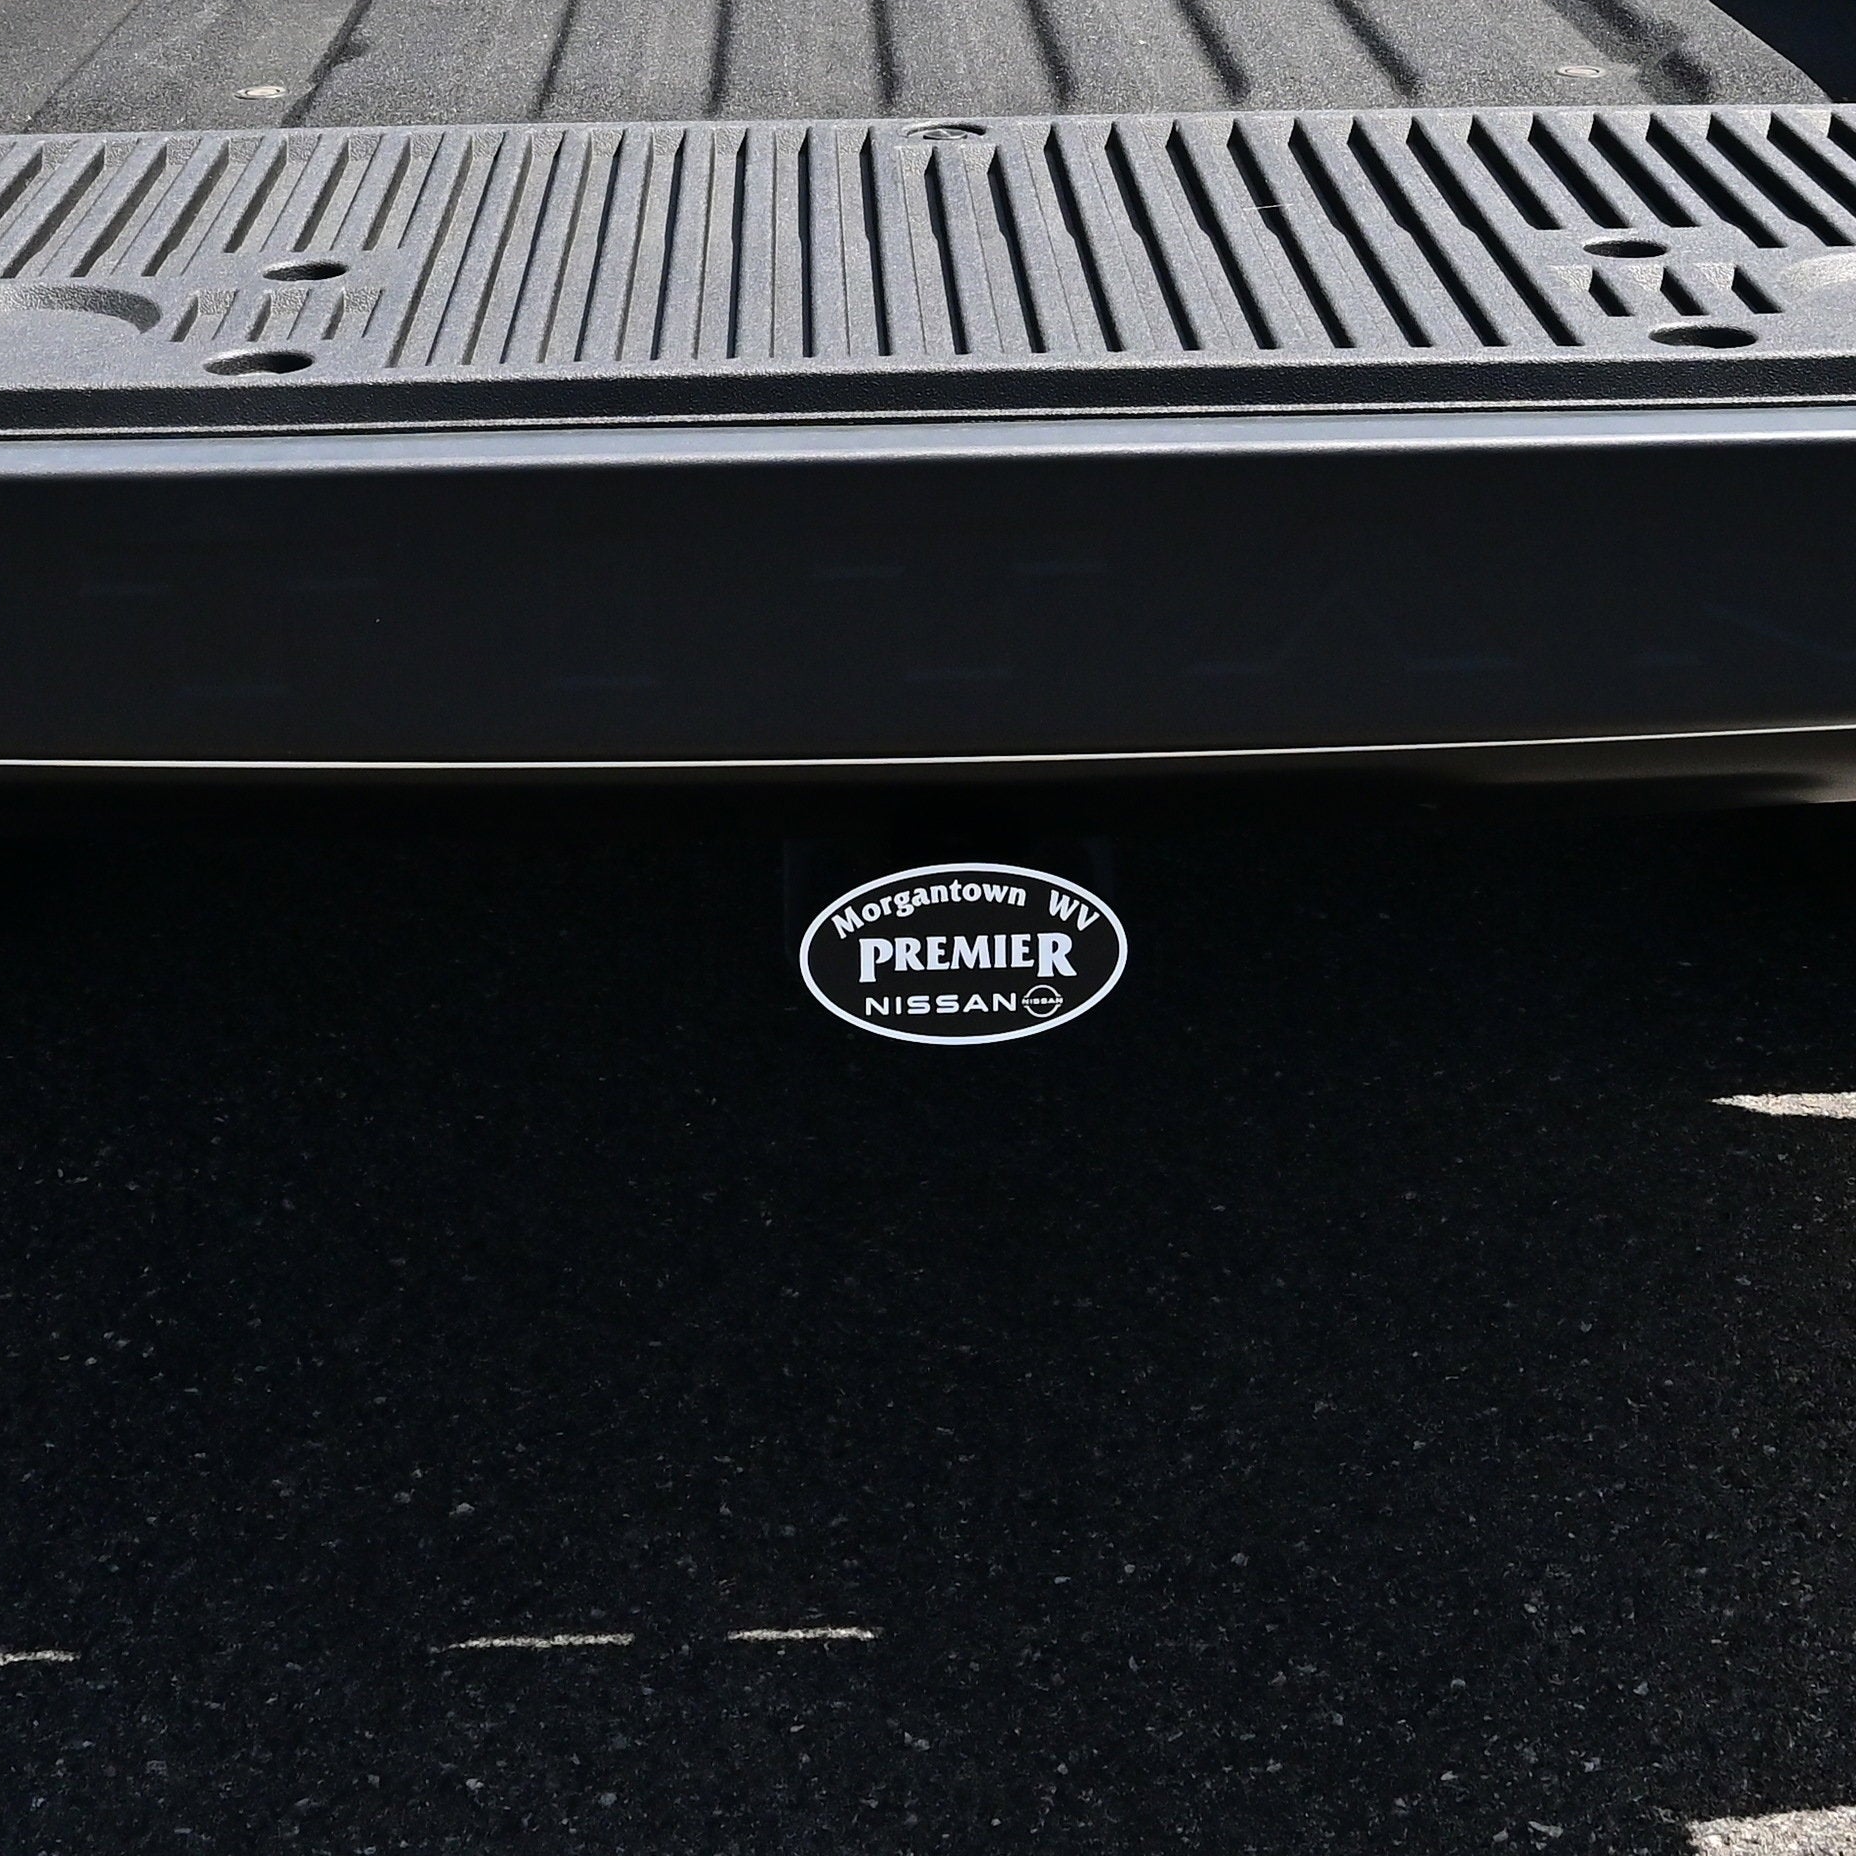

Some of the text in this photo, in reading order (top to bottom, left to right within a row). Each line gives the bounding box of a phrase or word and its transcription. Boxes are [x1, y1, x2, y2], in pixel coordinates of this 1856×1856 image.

[831, 879, 1100, 939] Morgantown WV
[858, 932, 1078, 983] PREMIER
[864, 992, 1017, 1016] NISSAN
[1022, 996, 1064, 1006] NISSAN
